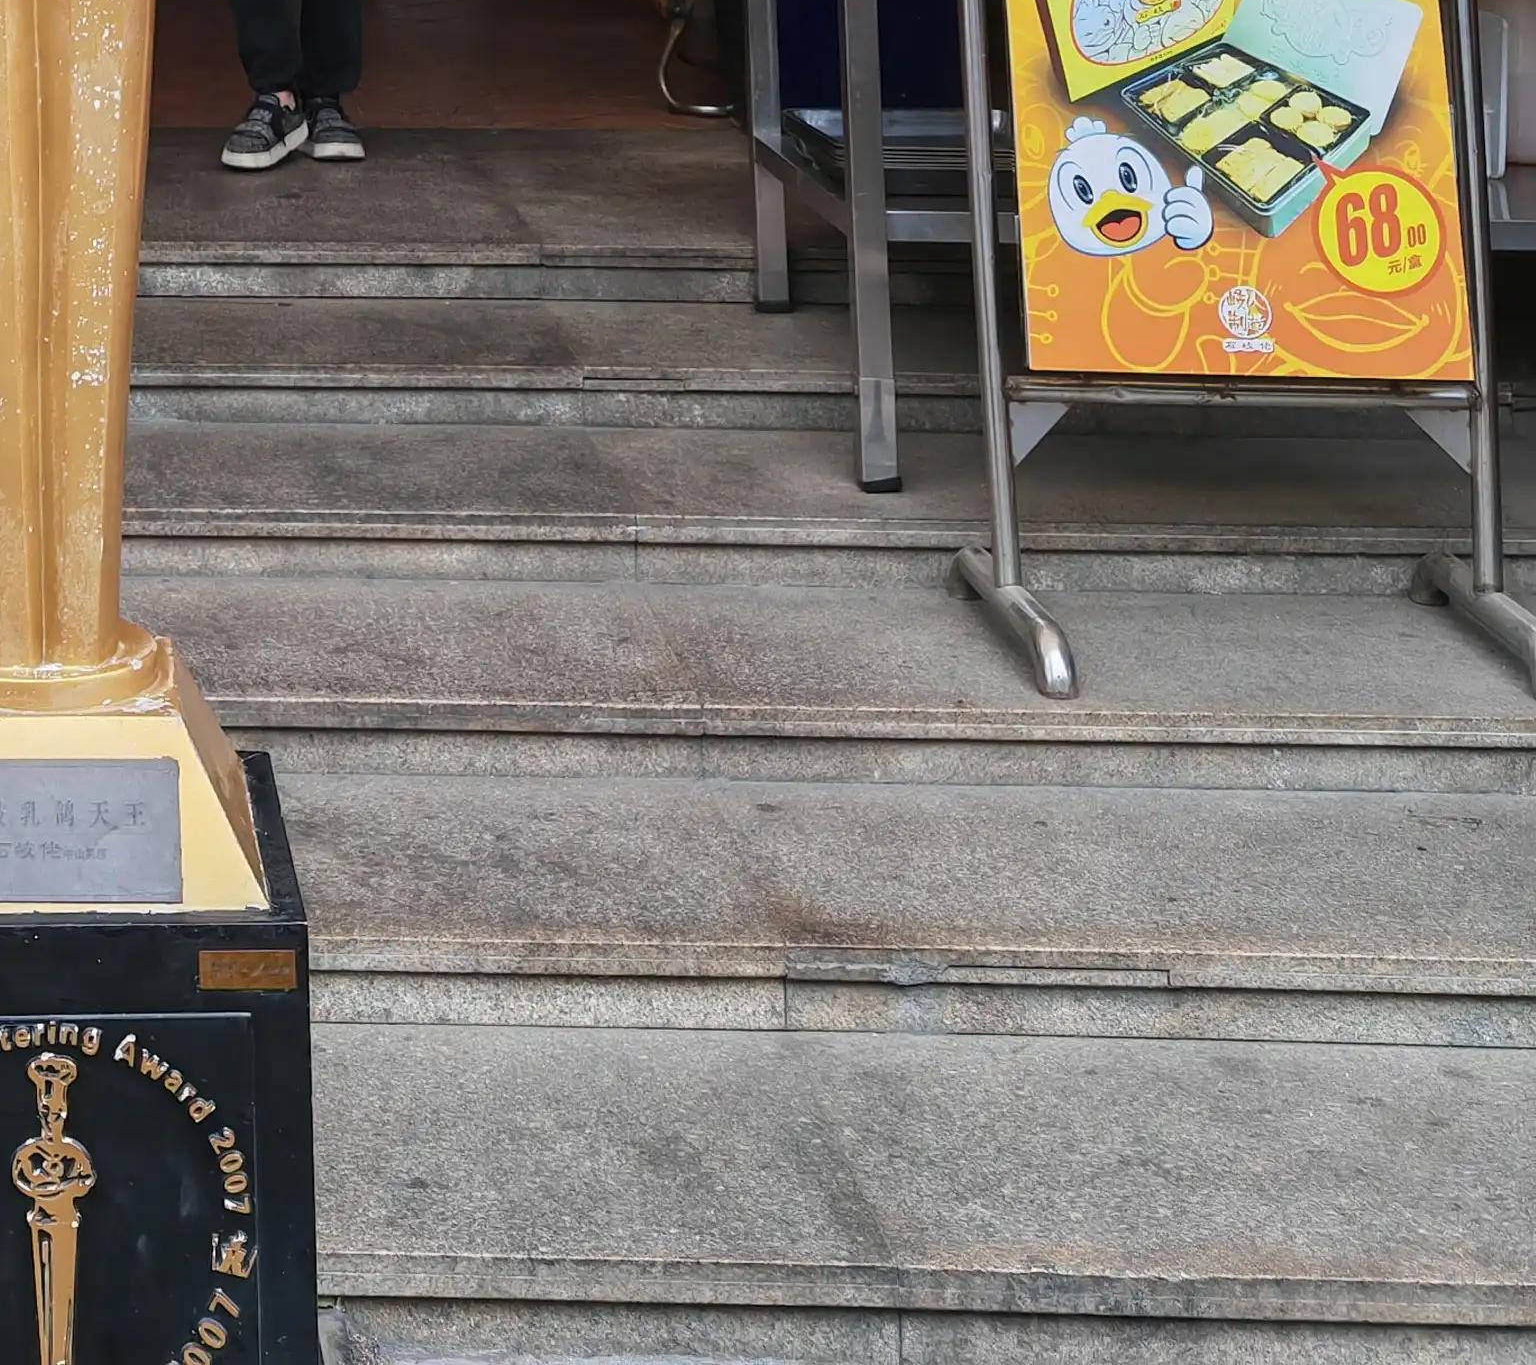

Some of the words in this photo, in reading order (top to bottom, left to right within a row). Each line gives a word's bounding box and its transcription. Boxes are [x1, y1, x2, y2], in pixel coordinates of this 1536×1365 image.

[1388, 253, 1424, 275] 元/盒
[113, 1033, 216, 1123] Award
[208, 1126, 253, 1214] 2007
